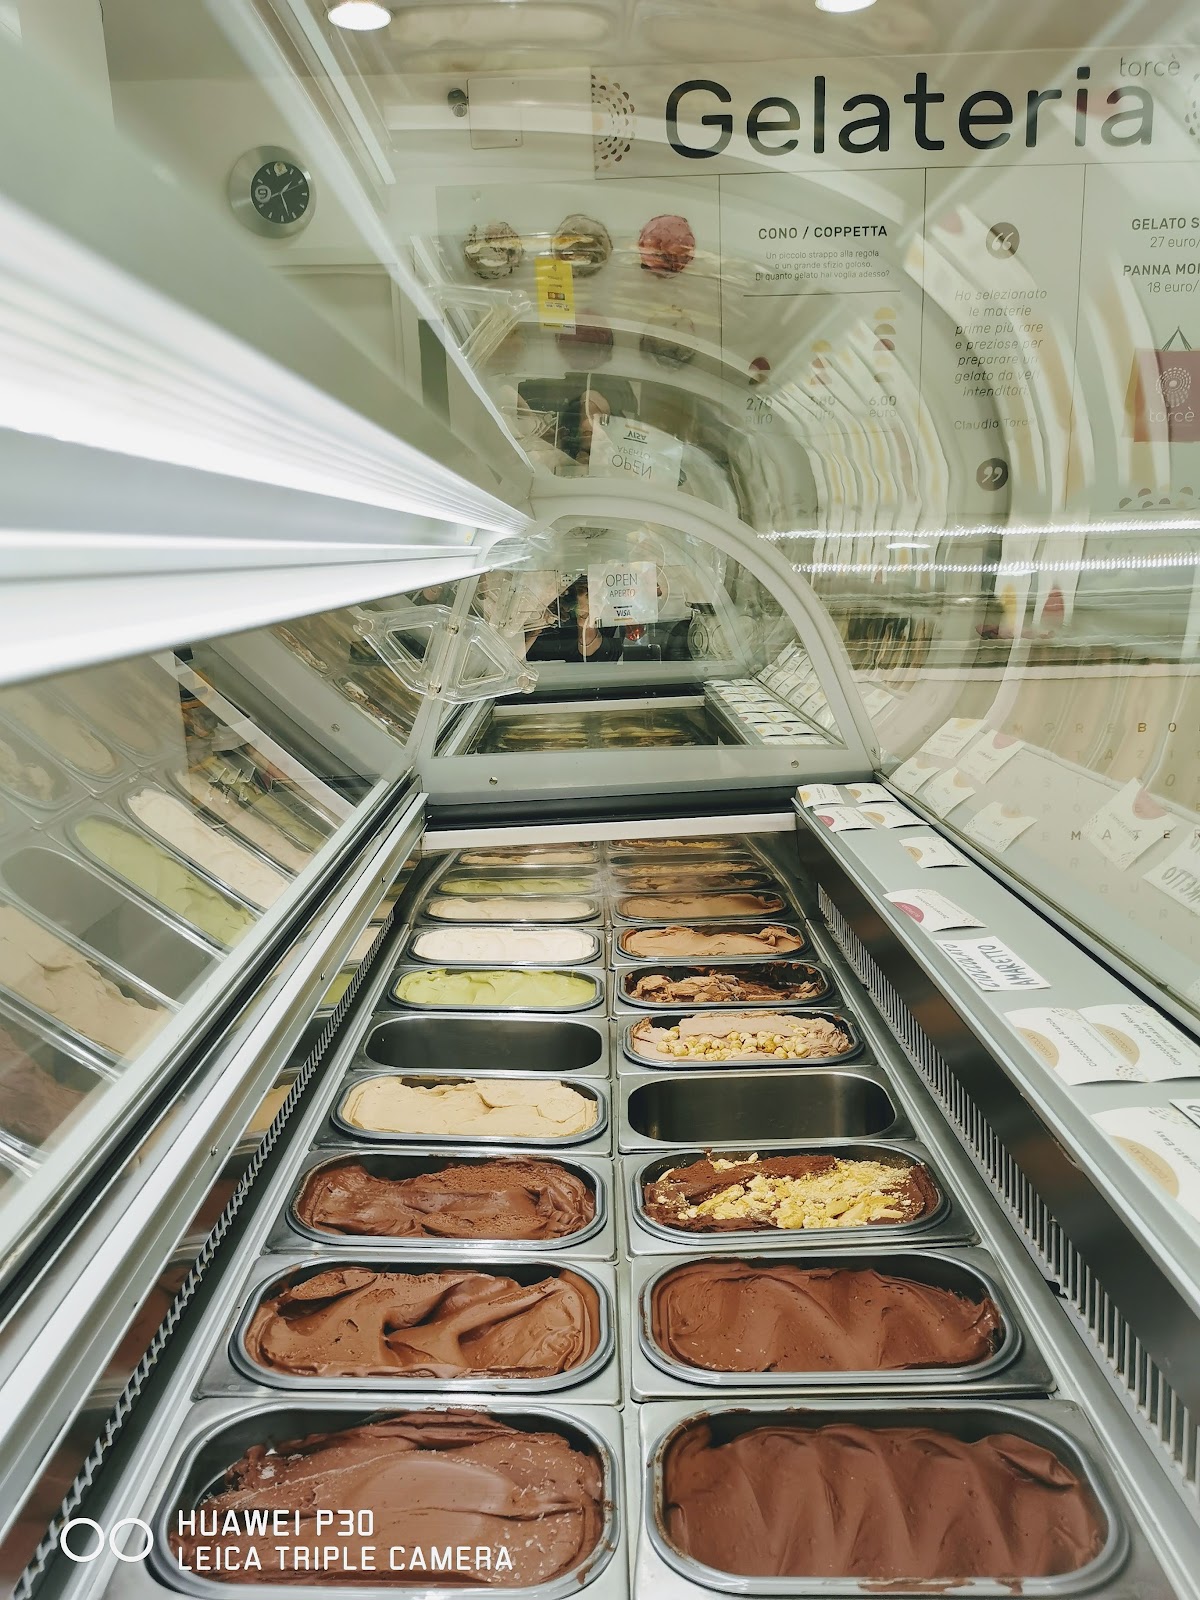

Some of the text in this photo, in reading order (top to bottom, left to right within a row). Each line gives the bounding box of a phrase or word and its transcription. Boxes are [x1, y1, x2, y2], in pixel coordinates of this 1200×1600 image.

[1119, 53, 1181, 77] torcè
[665, 66, 1154, 159] Gelateria
[1131, 217, 1186, 230] GELATO
[758, 227, 798, 239] CONO
[814, 225, 888, 238] COPPETTA
[1150, 236, 1165, 248] 27
[765, 249, 880, 261] Un piccolo strappo alla regola
[782, 262, 792, 270] un
[794, 261, 821, 271] grande
[823, 260, 844, 270] sfizio
[845, 261, 873, 271] goloso.
[1123, 263, 1200, 276] PANNA MO
[765, 272, 792, 282] quanto
[794, 271, 819, 281] gelato
[820, 270, 832, 279] hai
[833, 270, 857, 280] voglia
[858, 269, 890, 279] adesso?
[1147, 281, 1161, 293] 18
[954, 288, 1048, 301] Ho selezionato
[969, 305, 1032, 317] le materie
[954, 323, 991, 336] prime
[994, 322, 1014, 336] più
[955, 338, 1044, 351] e preziose per
[957, 355, 1019, 367] preparare
[954, 370, 994, 384] gelato
[998, 369, 1013, 381] da
[1149, 406, 1195, 423] torcè
[954, 418, 999, 430] Claudio
[605, 573, 638, 587] OPEN
[609, 588, 636, 598] APERTO
[616, 609, 632, 617] VISA
[943, 943, 1000, 988] CIOCCOLATO
[977, 944, 1040, 986] AMARETTO
[1120, 1012, 1135, 1024] Rosa
[1045, 1017, 1066, 1035] Arancia
[1133, 1024, 1147, 1034] Sale
[1067, 1040, 1097, 1067] Cioccolato
[1150, 1038, 1182, 1066] Cioccolato
[1153, 1130, 1175, 1146] Easy
